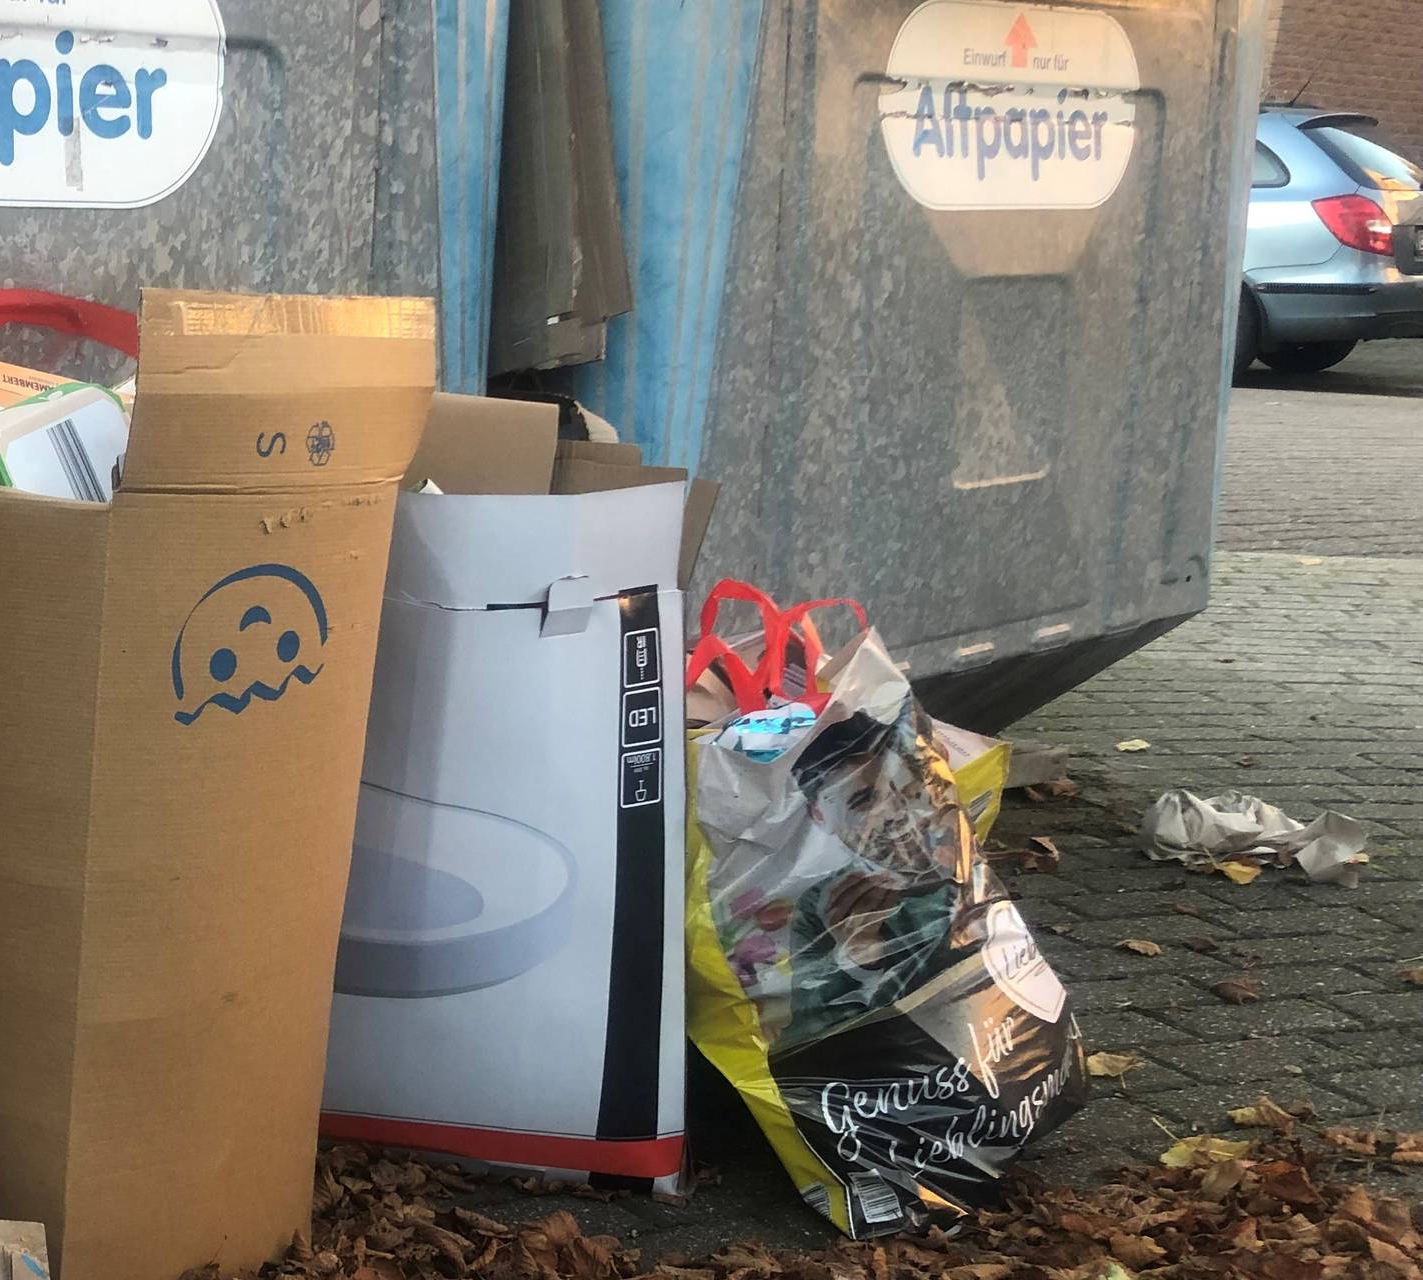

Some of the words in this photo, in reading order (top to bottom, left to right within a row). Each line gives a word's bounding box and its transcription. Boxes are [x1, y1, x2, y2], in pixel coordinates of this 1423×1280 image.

[963, 48, 1007, 67] Einwurf
[1033, 55, 1052, 70] nur
[1054, 53, 1070, 71] für
[912, 83, 1109, 181] Altpapier
[628, 706, 656, 727] LED
[821, 1056, 972, 1161] Genuss
[967, 1016, 1015, 1099] für
